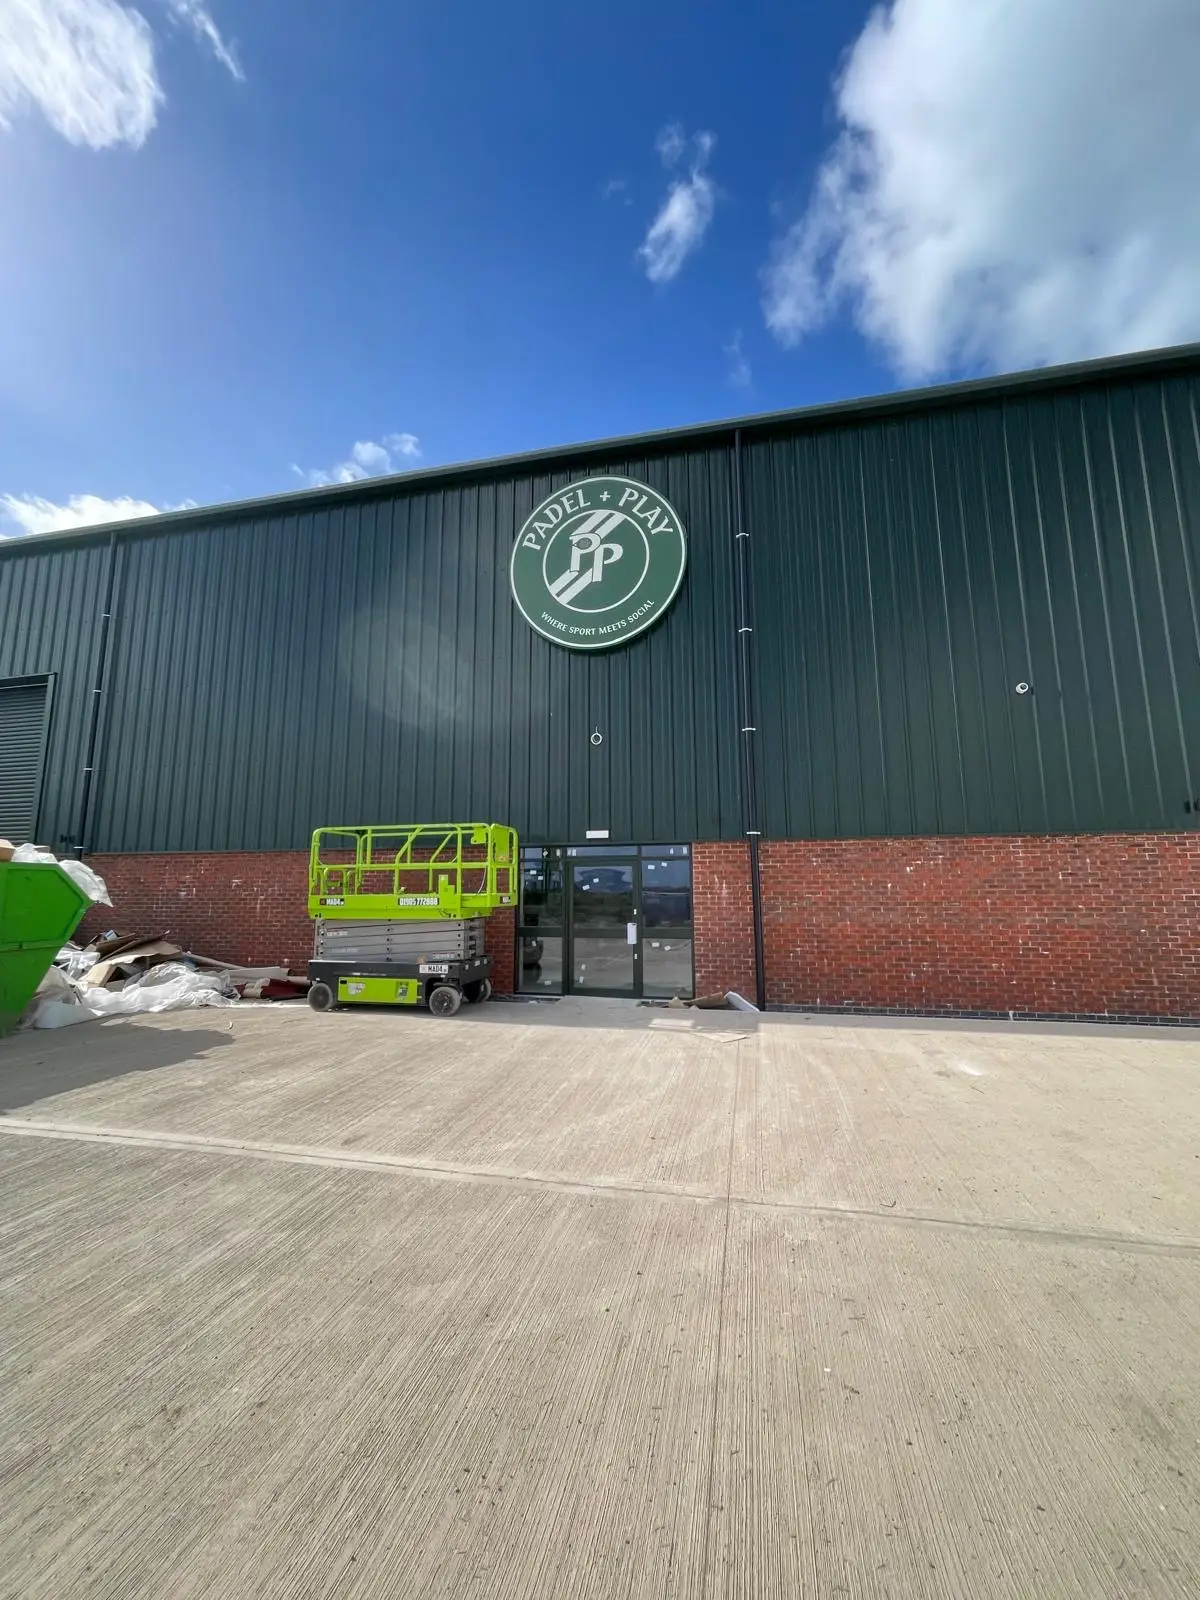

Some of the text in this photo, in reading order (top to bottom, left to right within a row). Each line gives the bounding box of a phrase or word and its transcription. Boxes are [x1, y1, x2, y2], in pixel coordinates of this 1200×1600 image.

[522, 488, 591, 550] PADEL
[618, 487, 674, 535] PLAY
[541, 599, 655, 636] WHERE SPORT MEETS SOCIAL
